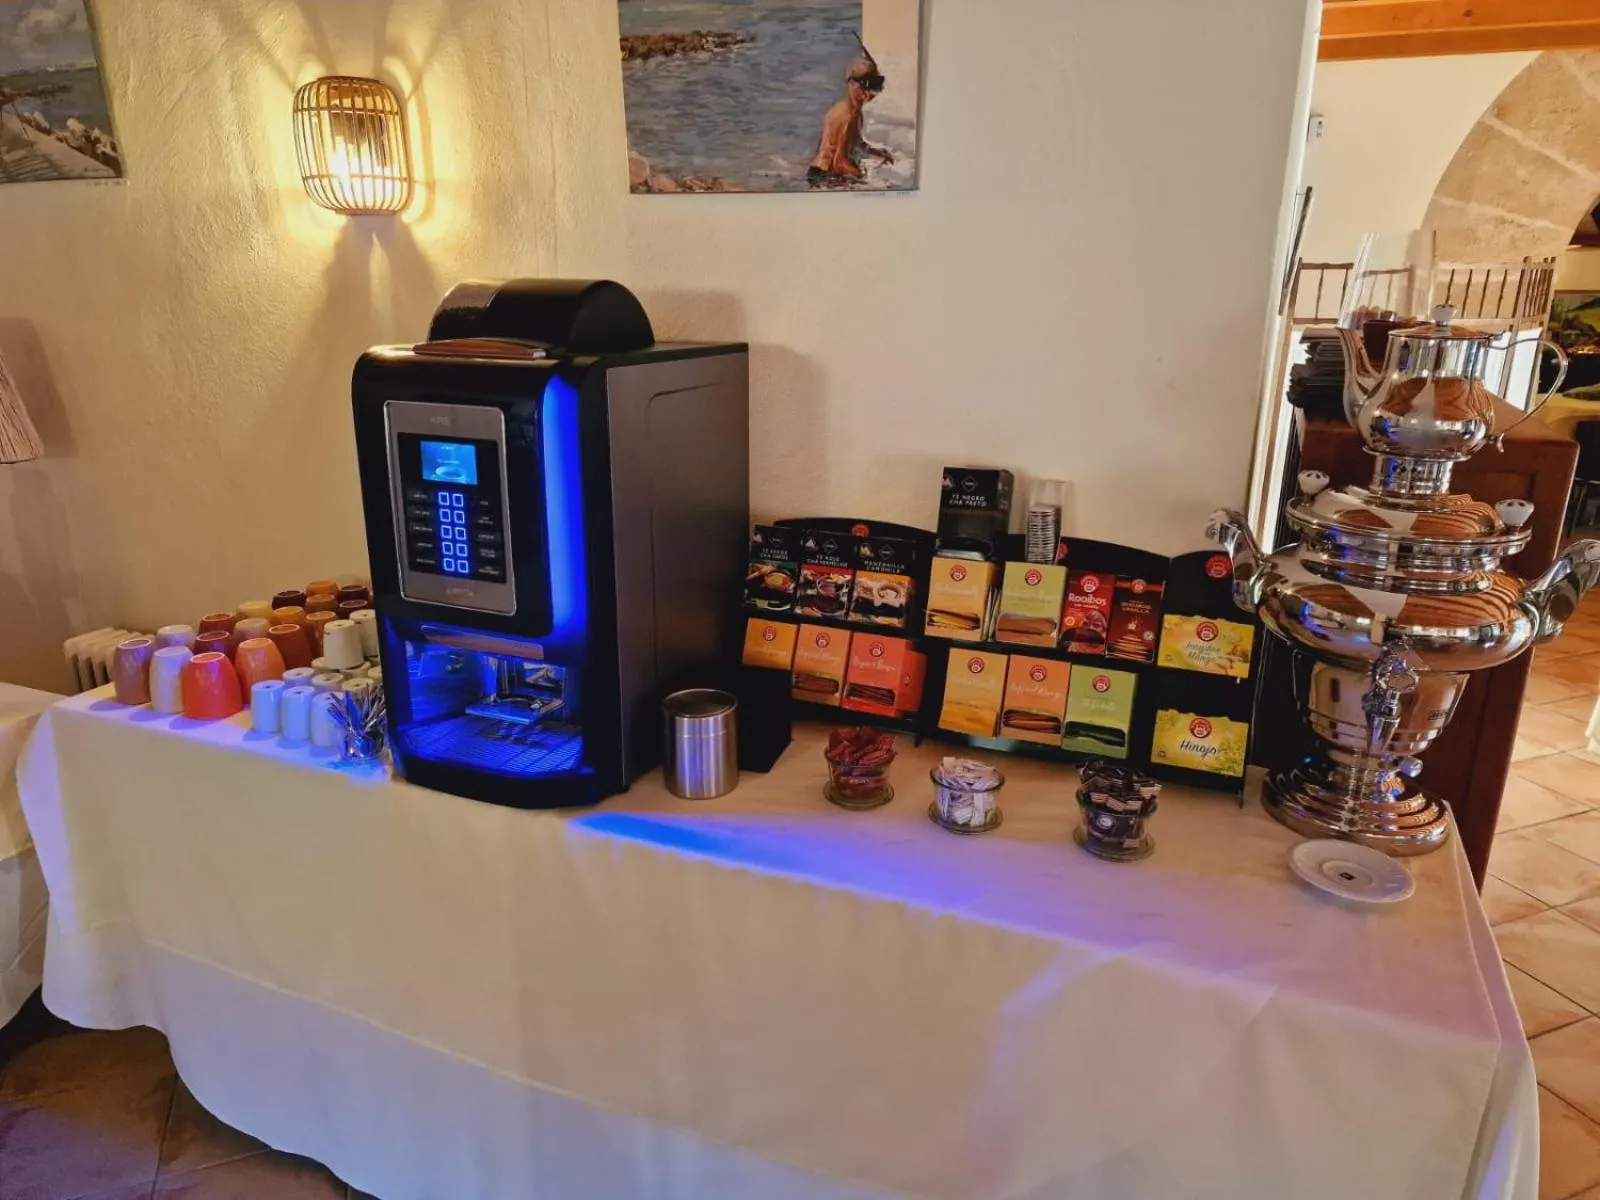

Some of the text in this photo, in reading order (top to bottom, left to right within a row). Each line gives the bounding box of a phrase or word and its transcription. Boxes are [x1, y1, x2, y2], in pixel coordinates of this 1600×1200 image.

[864, 559, 905, 570] MANZANILLA
[1068, 592, 1107, 606] Rooibos
[1180, 739, 1217, 758] Hinojo
